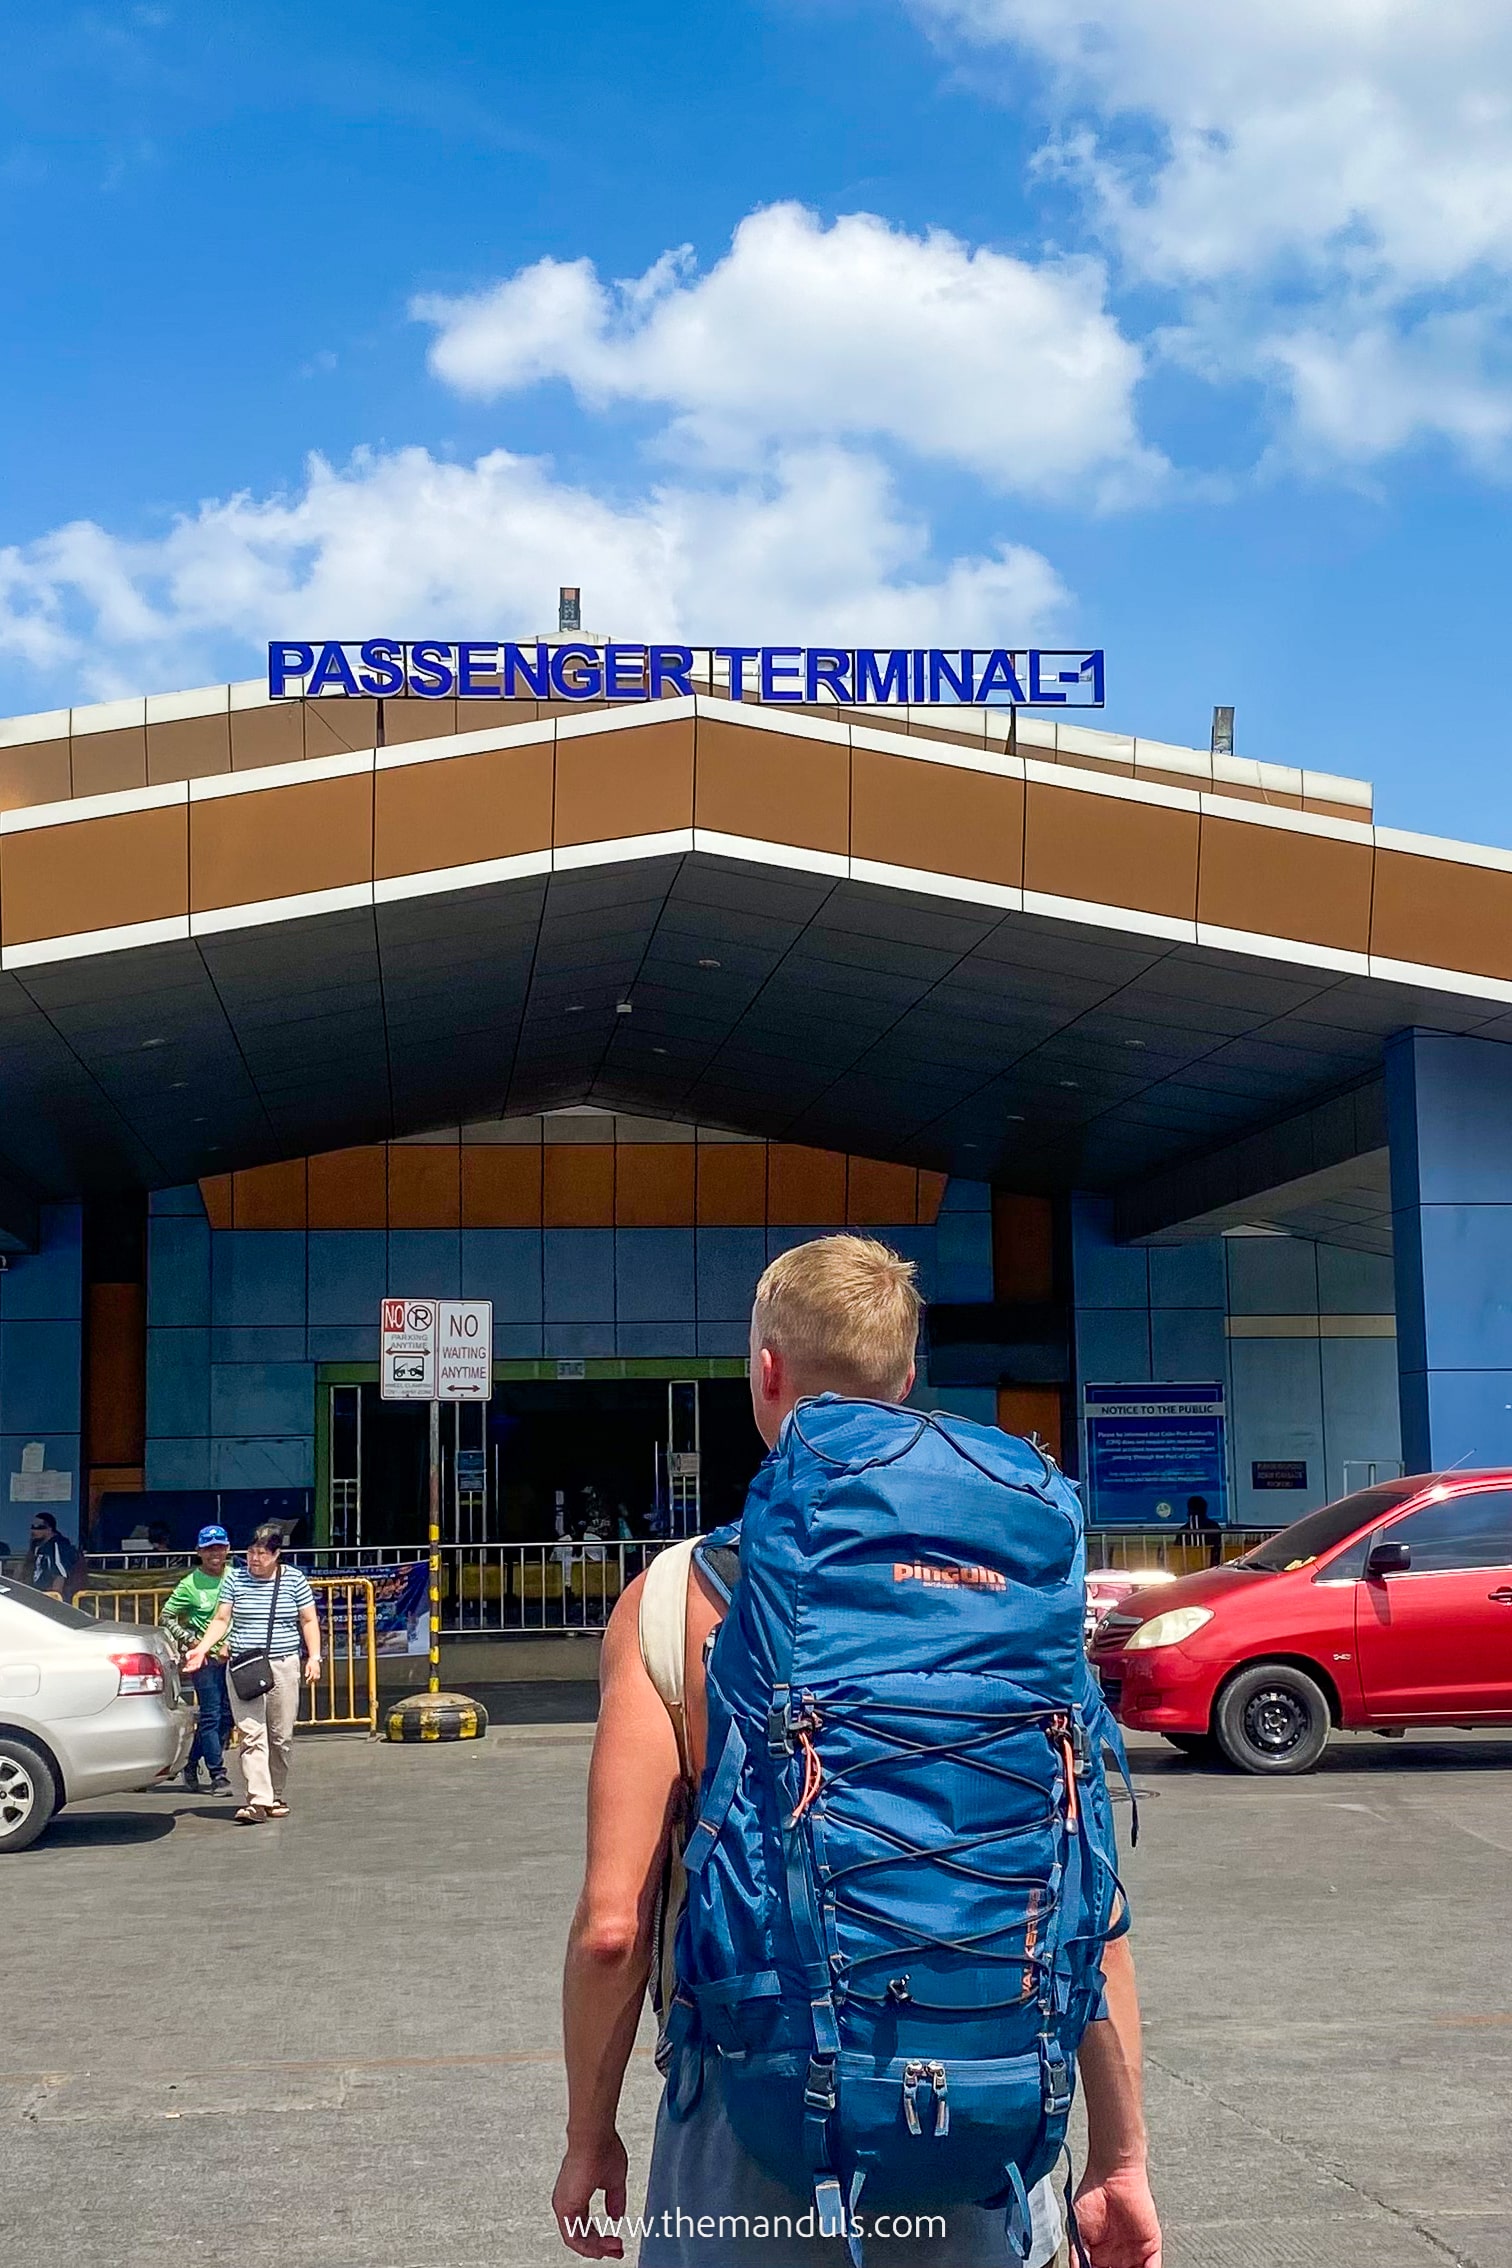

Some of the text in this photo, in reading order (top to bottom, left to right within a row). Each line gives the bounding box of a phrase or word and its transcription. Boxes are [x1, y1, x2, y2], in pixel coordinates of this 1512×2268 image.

[269, 638, 1105, 704] PASSENGER TERMINAL-1
[385, 1305, 404, 1329] NO
[450, 1314, 478, 1338] NO
[391, 1334, 428, 1342] PARKING
[391, 1342, 428, 1350] ANYTIME
[442, 1347, 486, 1359] WAITING
[441, 1366, 487, 1379] ANYTIME
[1101, 1405, 1213, 1415] NOTICE TO THE PUBLIC
